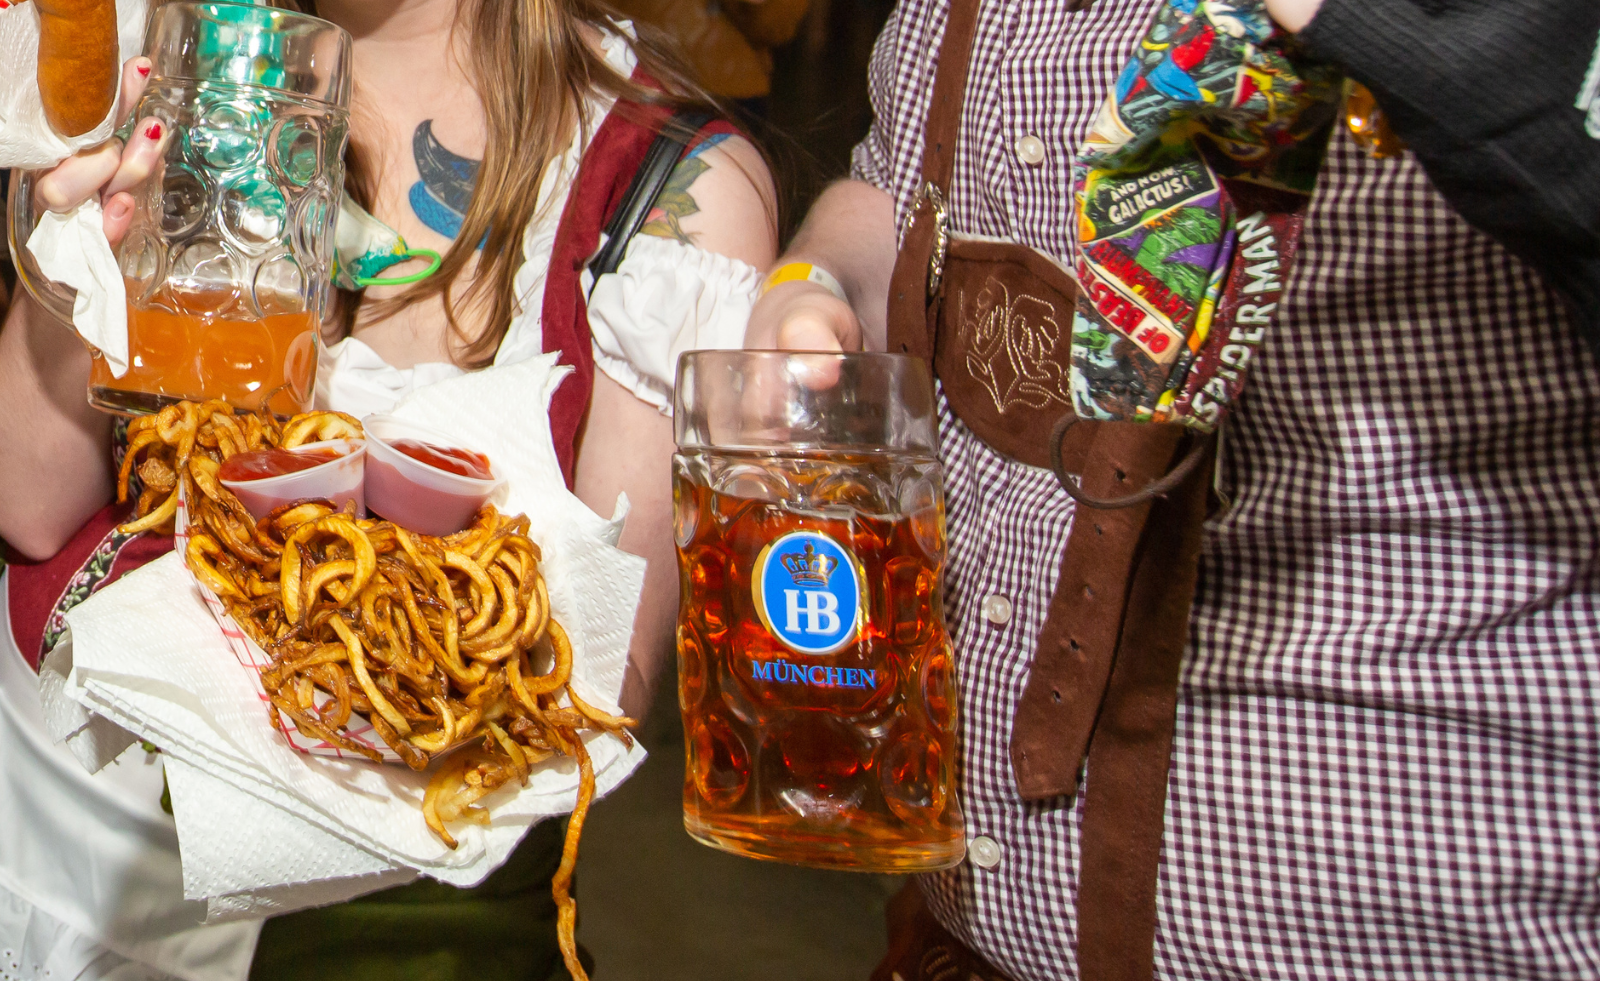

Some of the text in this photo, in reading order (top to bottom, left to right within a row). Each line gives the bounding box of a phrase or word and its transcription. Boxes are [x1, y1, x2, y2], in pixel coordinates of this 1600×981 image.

[1108, 174, 1193, 224] GALACTUS!
[1110, 181, 1138, 203] AND
[1136, 326, 1170, 354] OF
[783, 588, 842, 635] HB
[751, 659, 877, 690] MÜNCHEN
